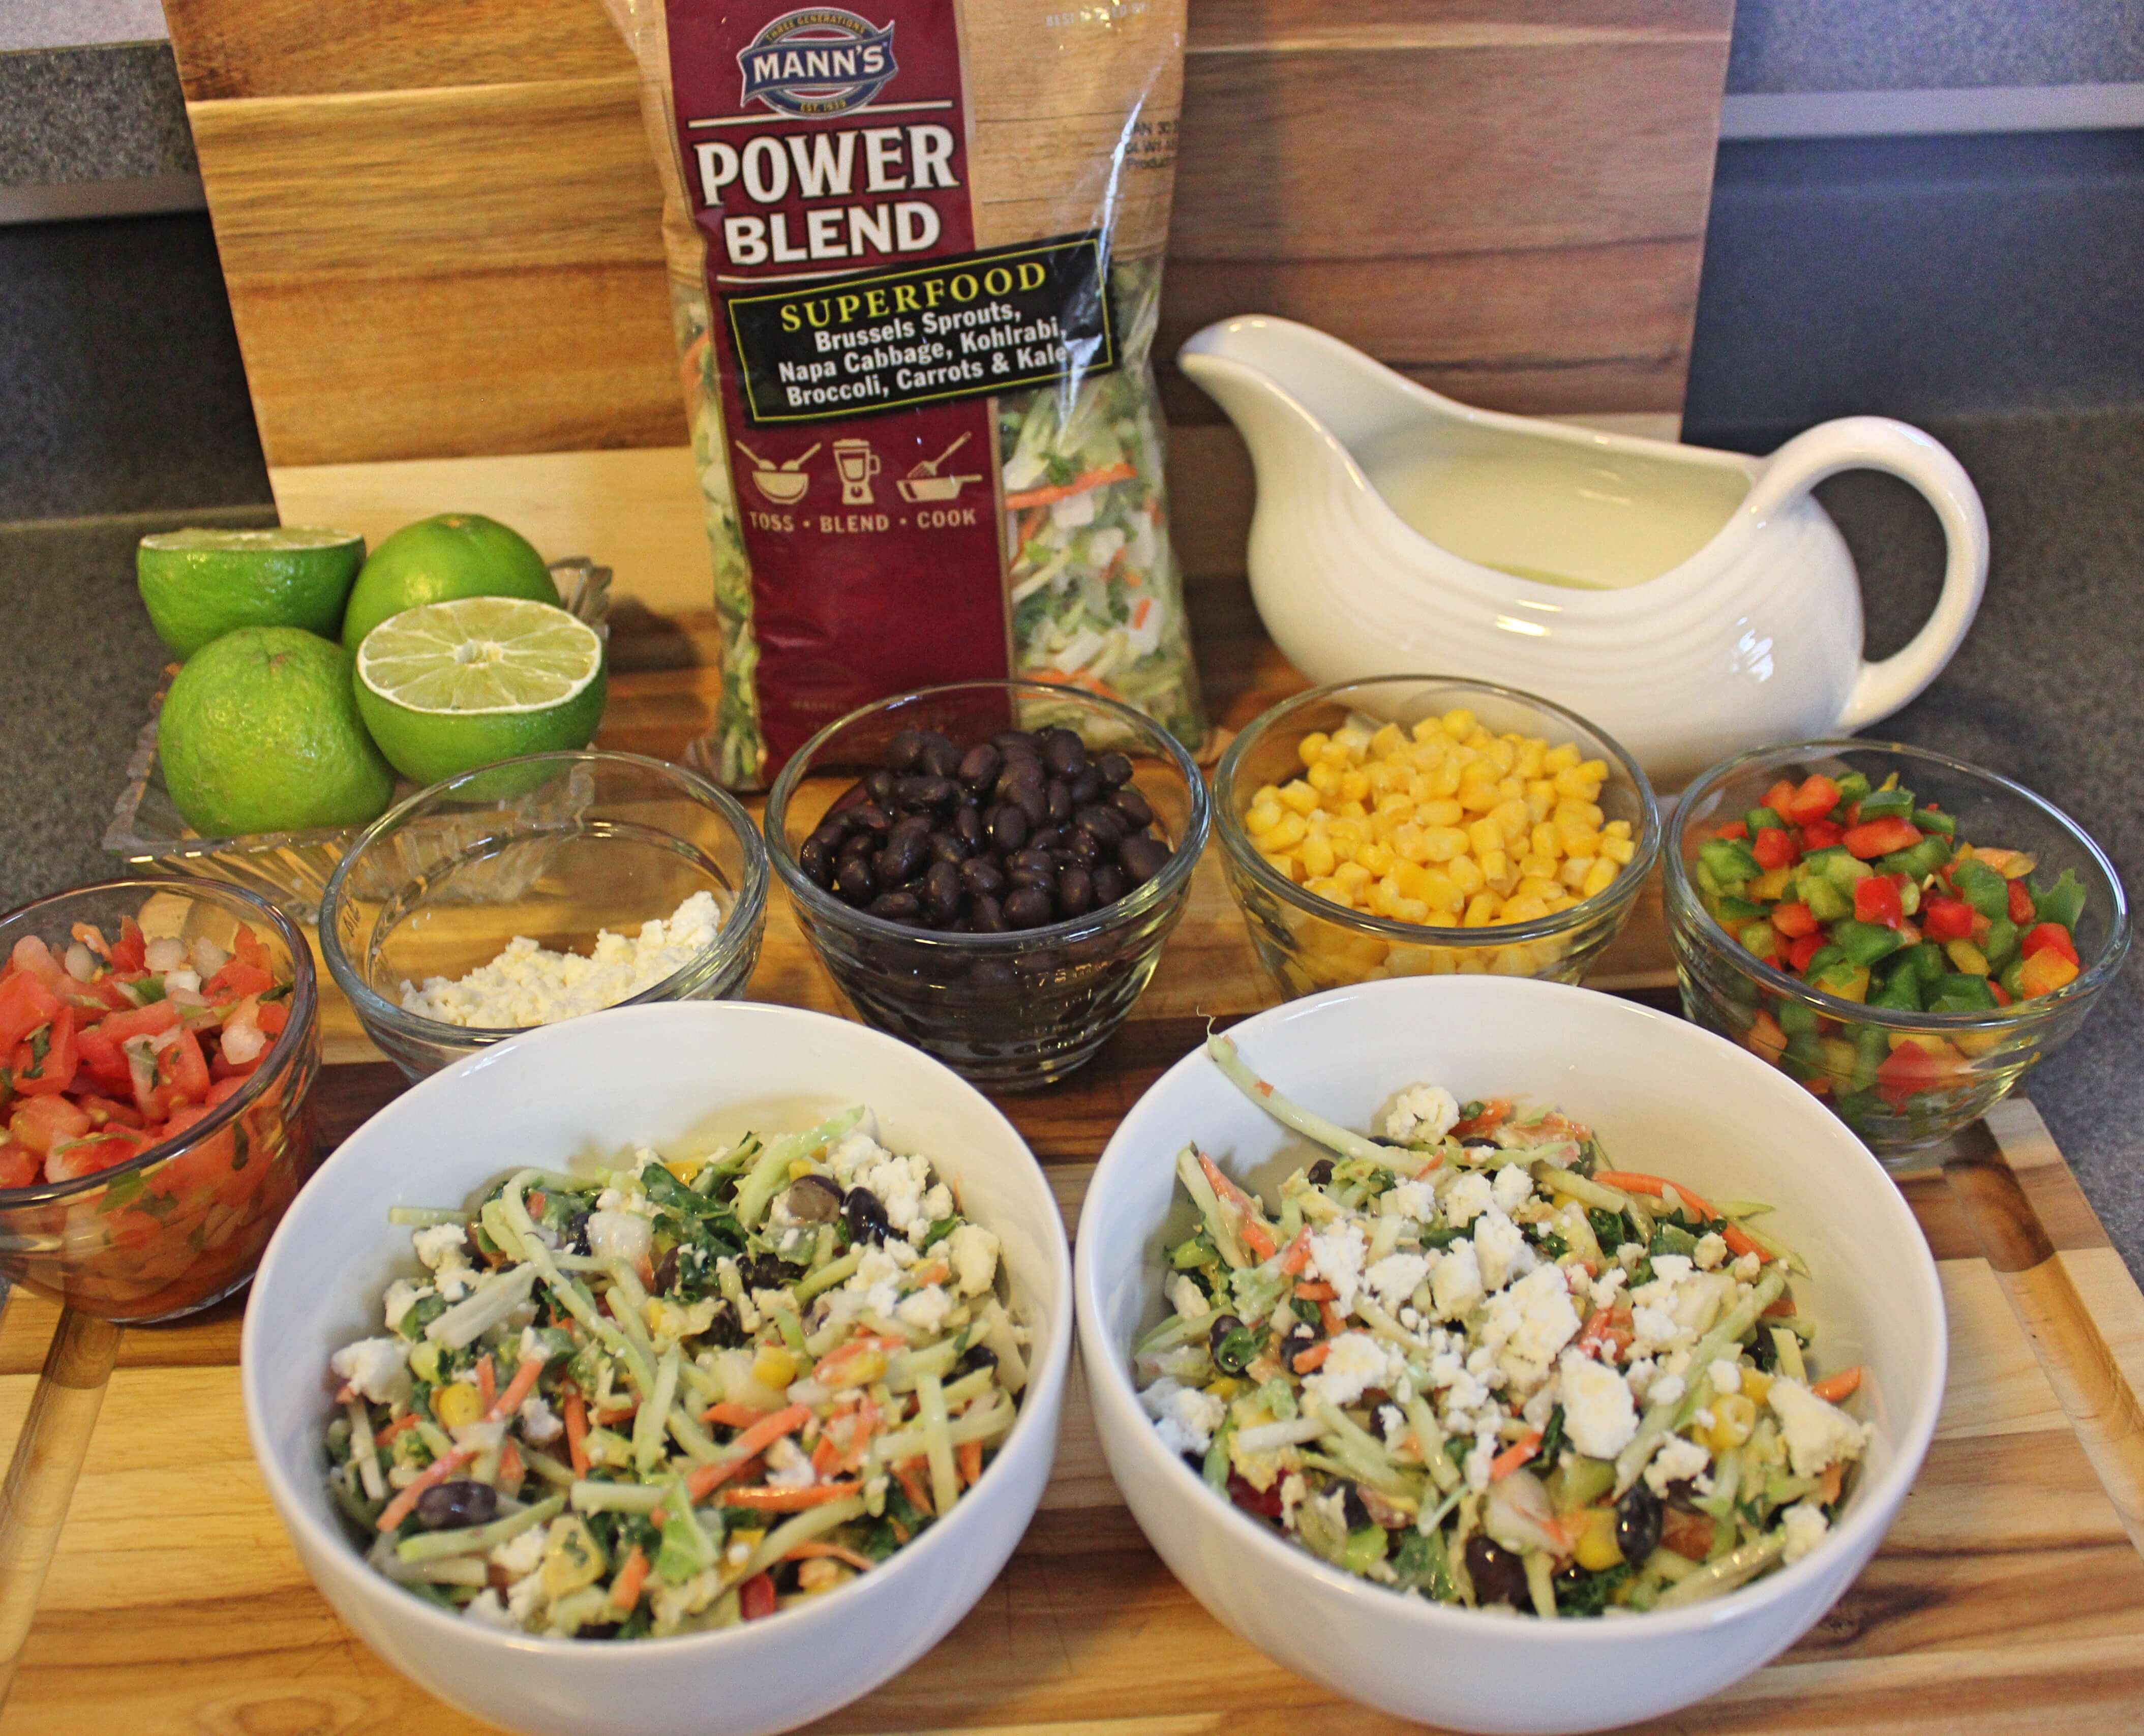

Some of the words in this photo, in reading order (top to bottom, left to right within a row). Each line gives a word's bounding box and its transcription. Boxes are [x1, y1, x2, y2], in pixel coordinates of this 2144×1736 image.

[765, 19, 795, 41] THREE
[797, 15, 865, 33] GENERATIONS
[752, 44, 886, 84] MANN'S
[694, 125, 959, 205] POWER
[724, 203, 940, 265] BLEND
[779, 261, 1046, 333] SUPERFOOD
[813, 317, 916, 353] Brussels
[921, 301, 1021, 336] Sprouts,
[778, 359, 837, 384] Napa
[843, 338, 953, 374] Cabbage,
[960, 315, 1067, 354] Kohlrabi,
[786, 374, 890, 408] Broccoli,
[895, 357, 984, 391] Carrots
[990, 351, 1010, 374] &
[1016, 343, 1067, 370] Kale
[749, 511, 795, 532] TOSS
[819, 514, 890, 533] BLEND
[917, 508, 977, 529] COOK
